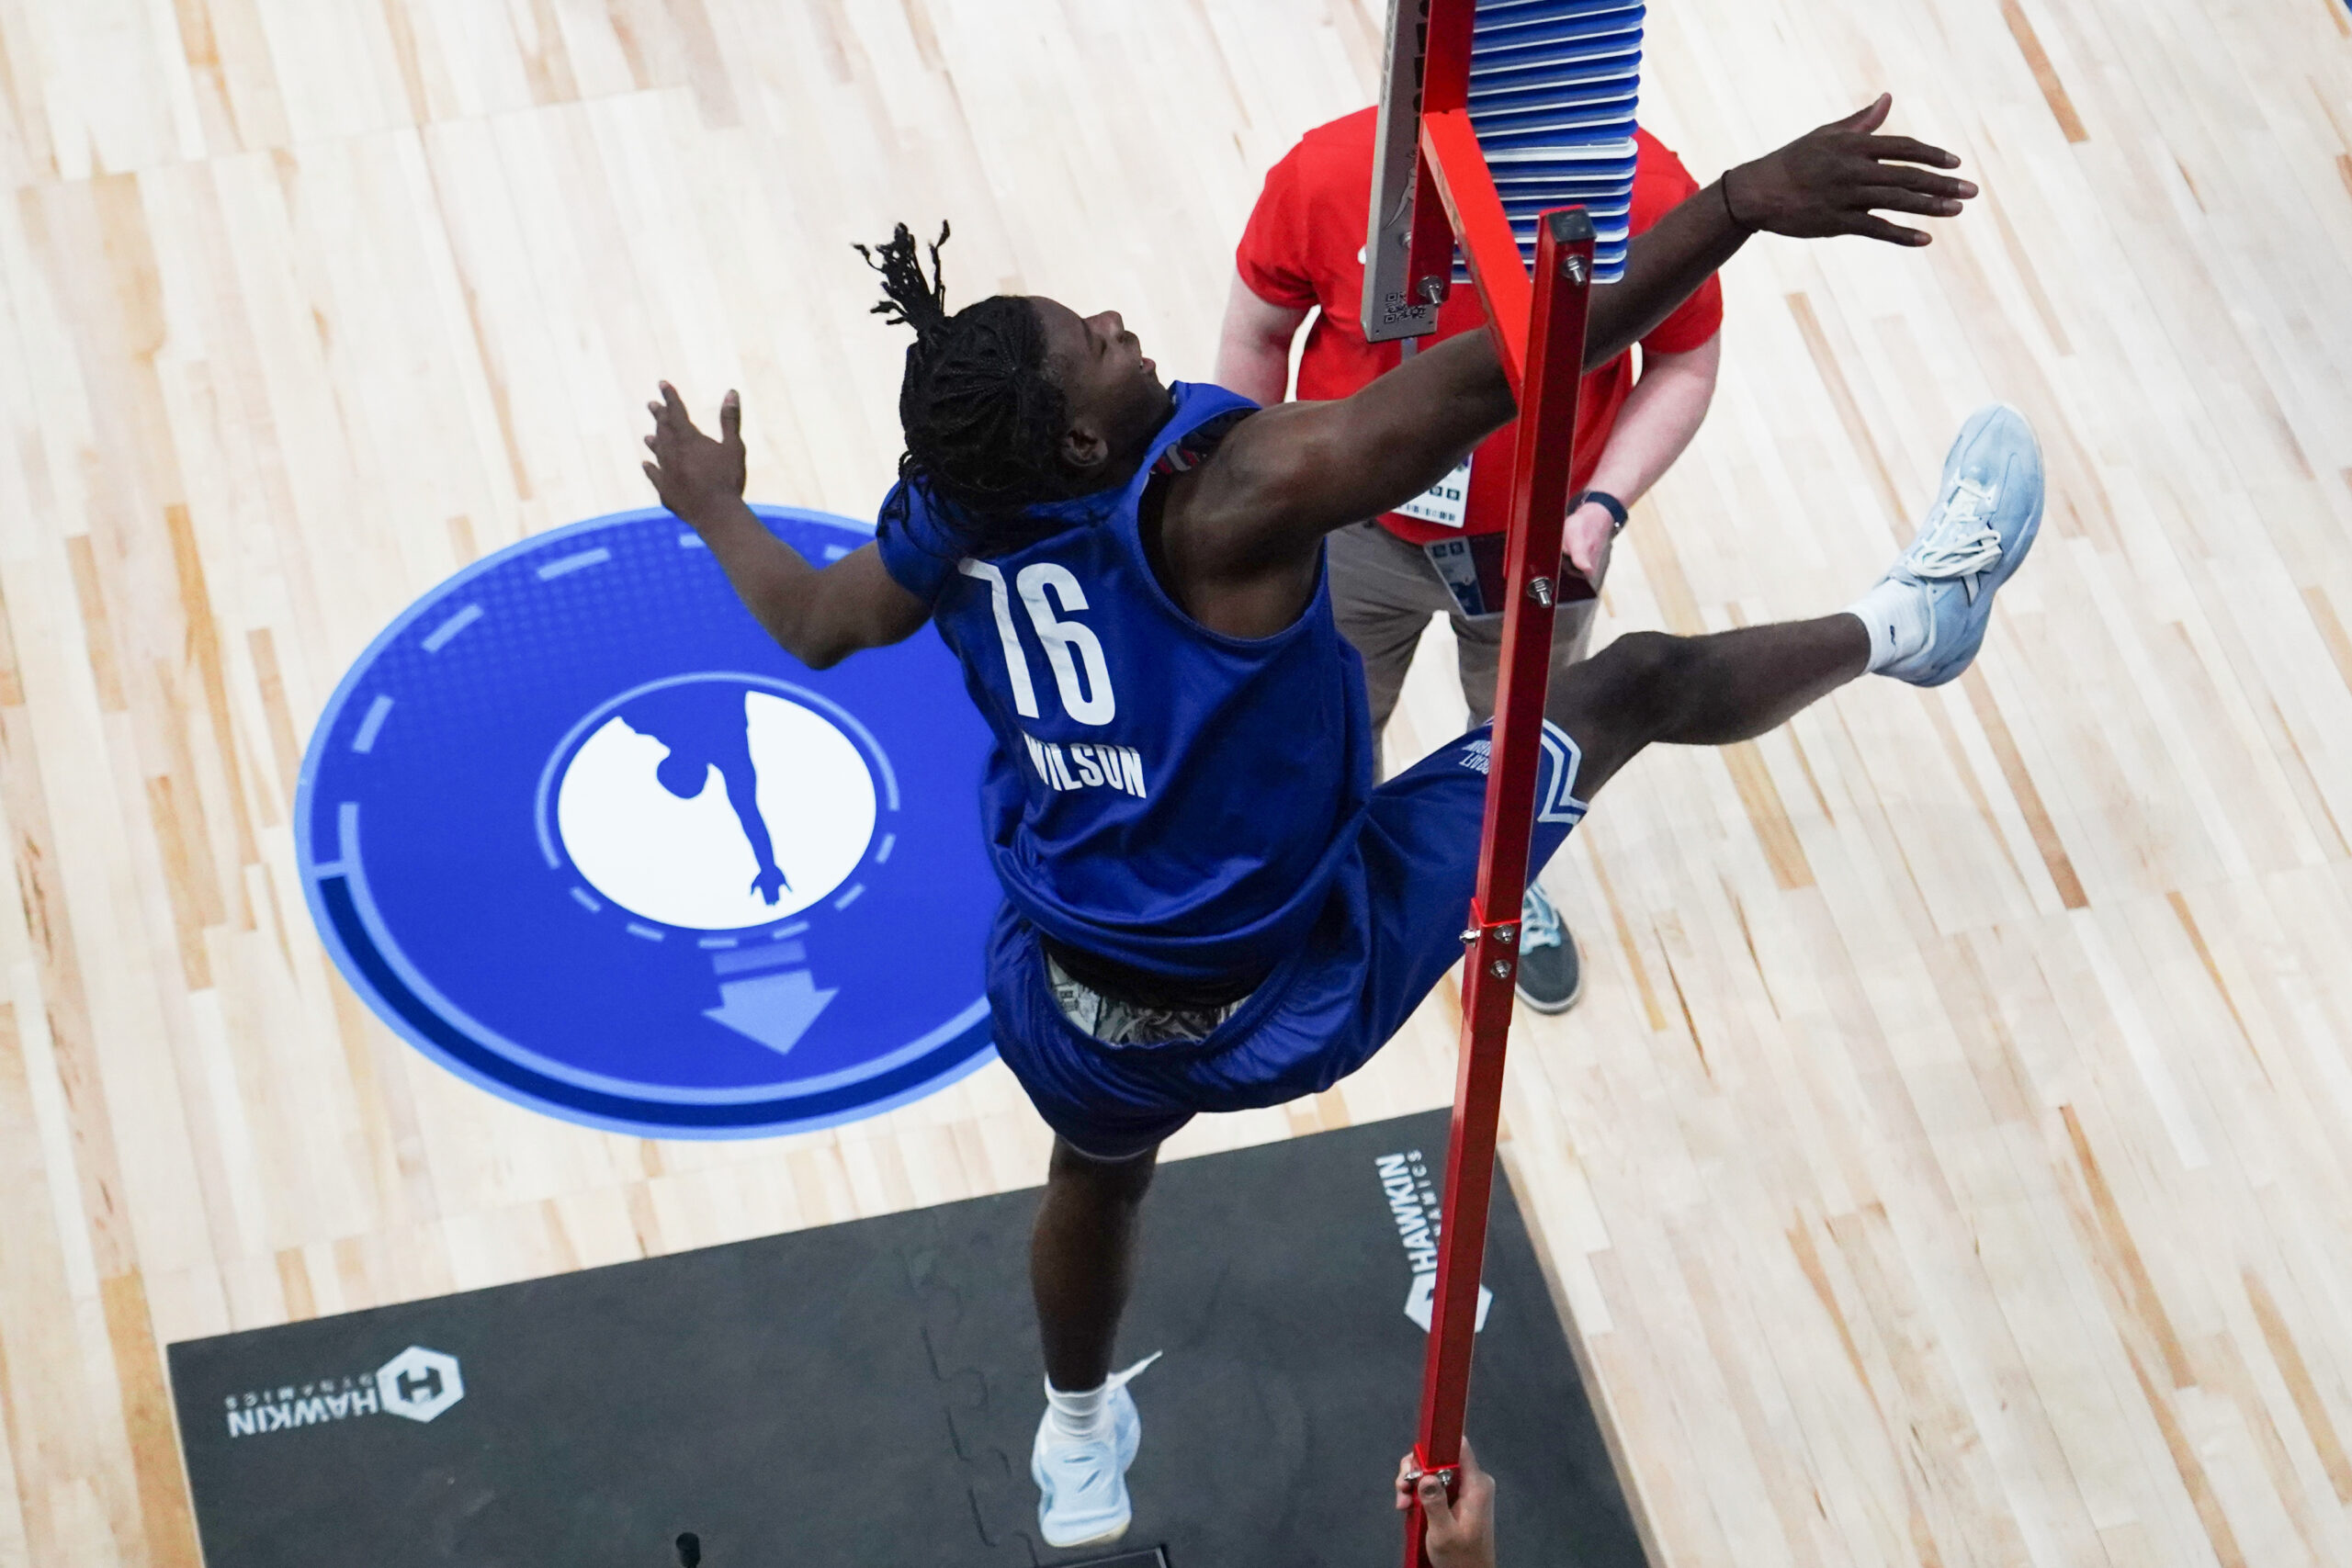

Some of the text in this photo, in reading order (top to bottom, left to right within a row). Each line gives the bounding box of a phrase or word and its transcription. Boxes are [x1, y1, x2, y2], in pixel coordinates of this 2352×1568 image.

[957, 557, 1115, 726] 76
[1022, 730, 1147, 798] WILSON
[1375, 1153, 1438, 1273] HAWKIN
[225, 1372, 374, 1410] DYNAMICS
[227, 1387, 379, 1438] HAWKIN
